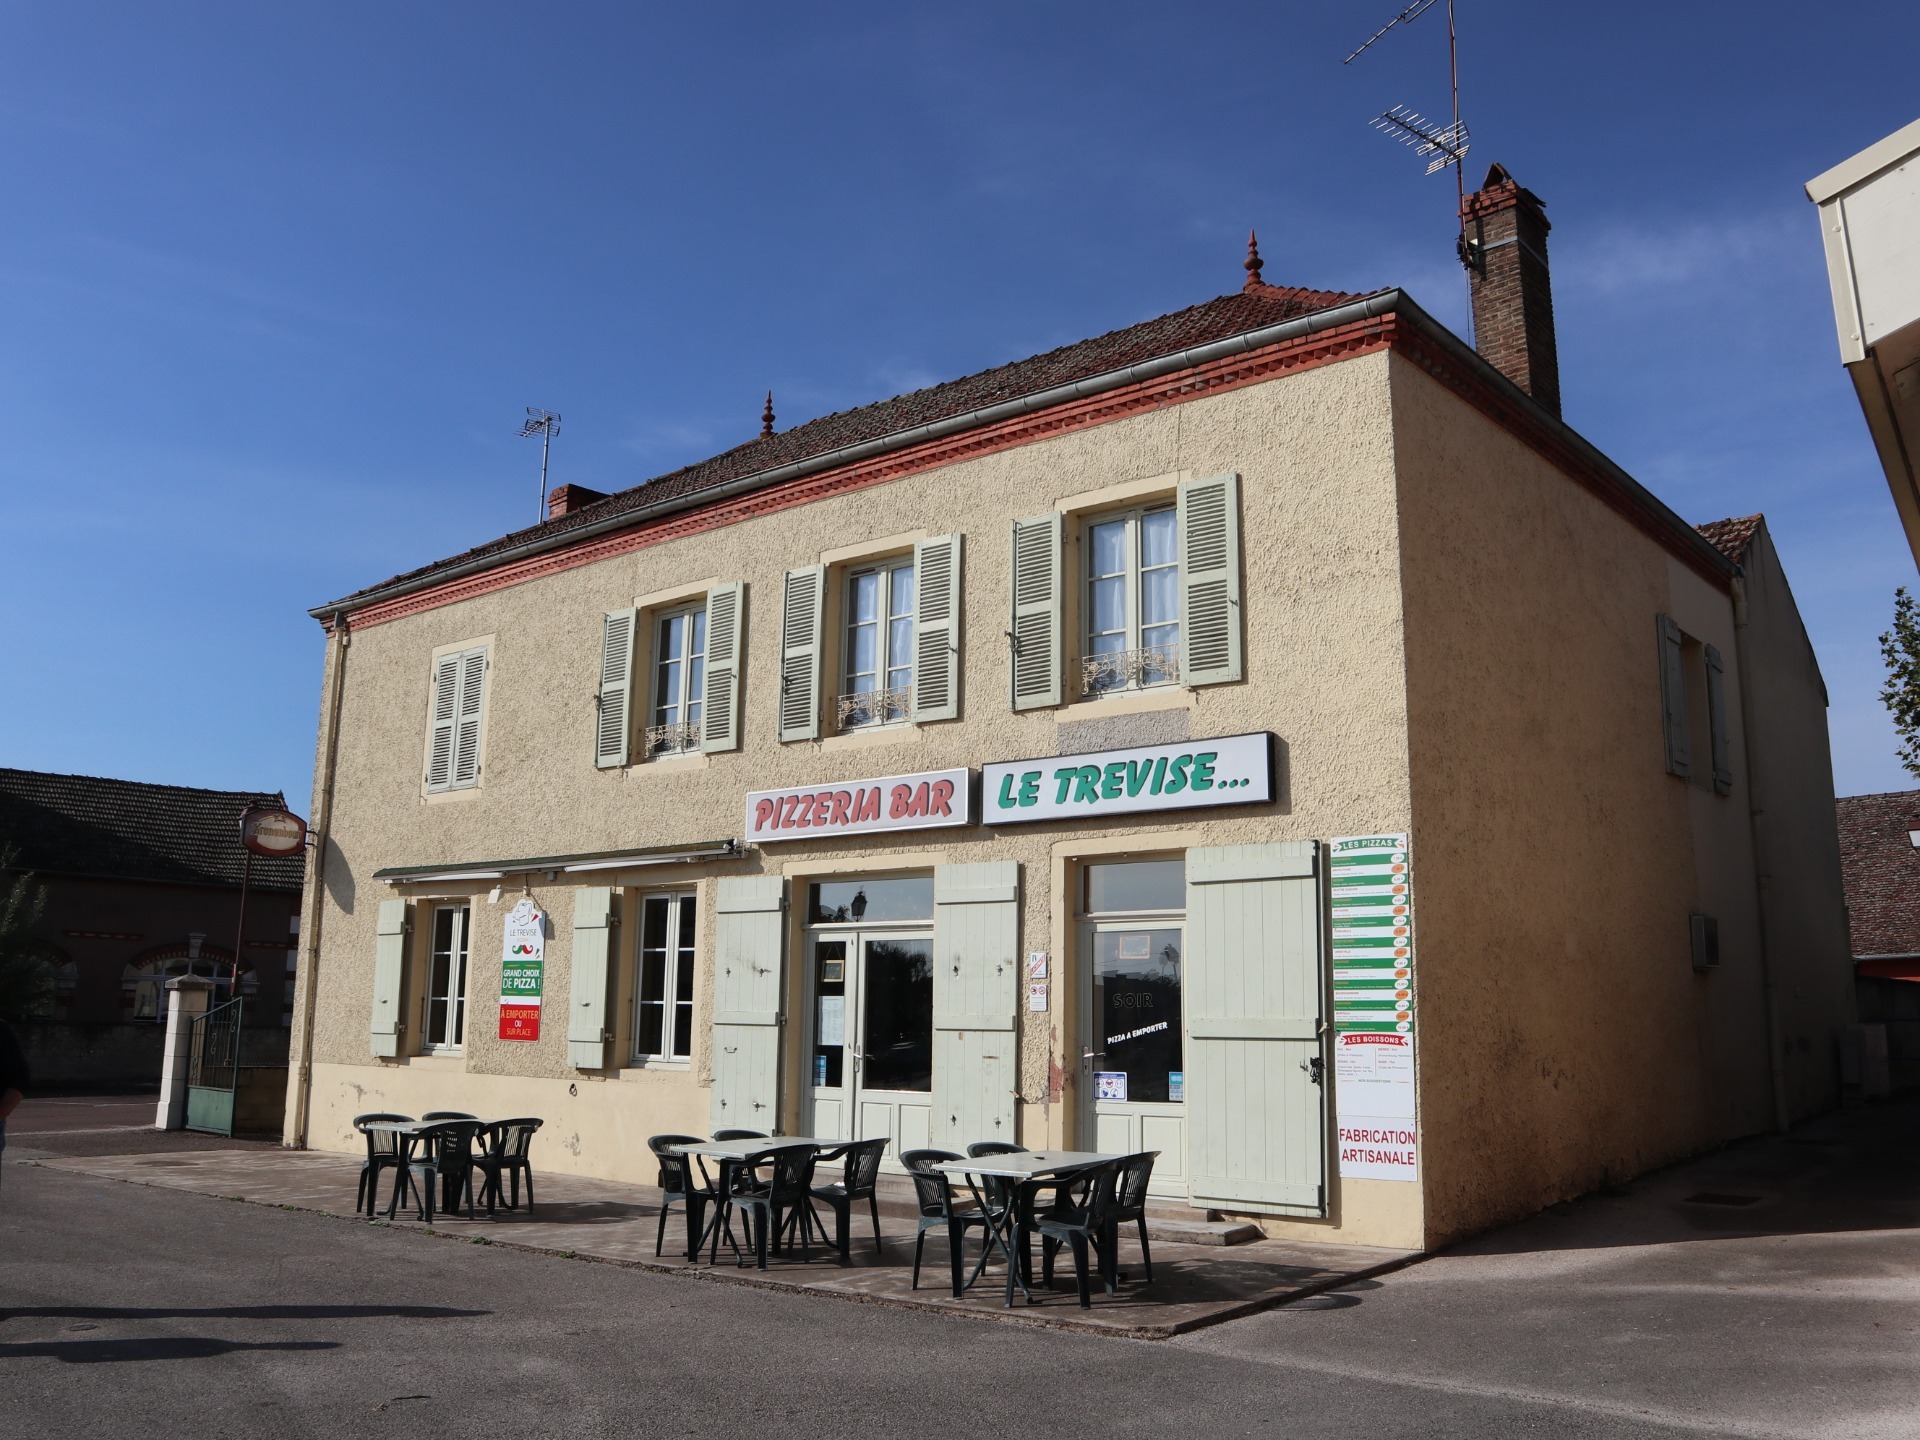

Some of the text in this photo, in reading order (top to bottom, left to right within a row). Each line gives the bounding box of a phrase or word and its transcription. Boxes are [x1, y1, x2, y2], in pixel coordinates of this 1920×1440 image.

[999, 751, 1250, 810] LE TREVISE...
[754, 779, 956, 832] PIZZERIA BAR
[1342, 841, 1359, 850] LES
[517, 928, 538, 937] TREVISE
[503, 969, 540, 977] GRAND CHOIX
[503, 978, 512, 989] DE
[513, 978, 536, 989] PIZZA
[1112, 992, 1154, 1008] SOIR
[500, 1008, 539, 1020] À EMPORTER
[516, 1028, 532, 1036] PLACE
[1107, 1022, 1168, 1045] PIZZA A EMPORTER
[1339, 1128, 1416, 1145] FABRICATION
[1342, 1149, 1415, 1165] ARTISANALE
